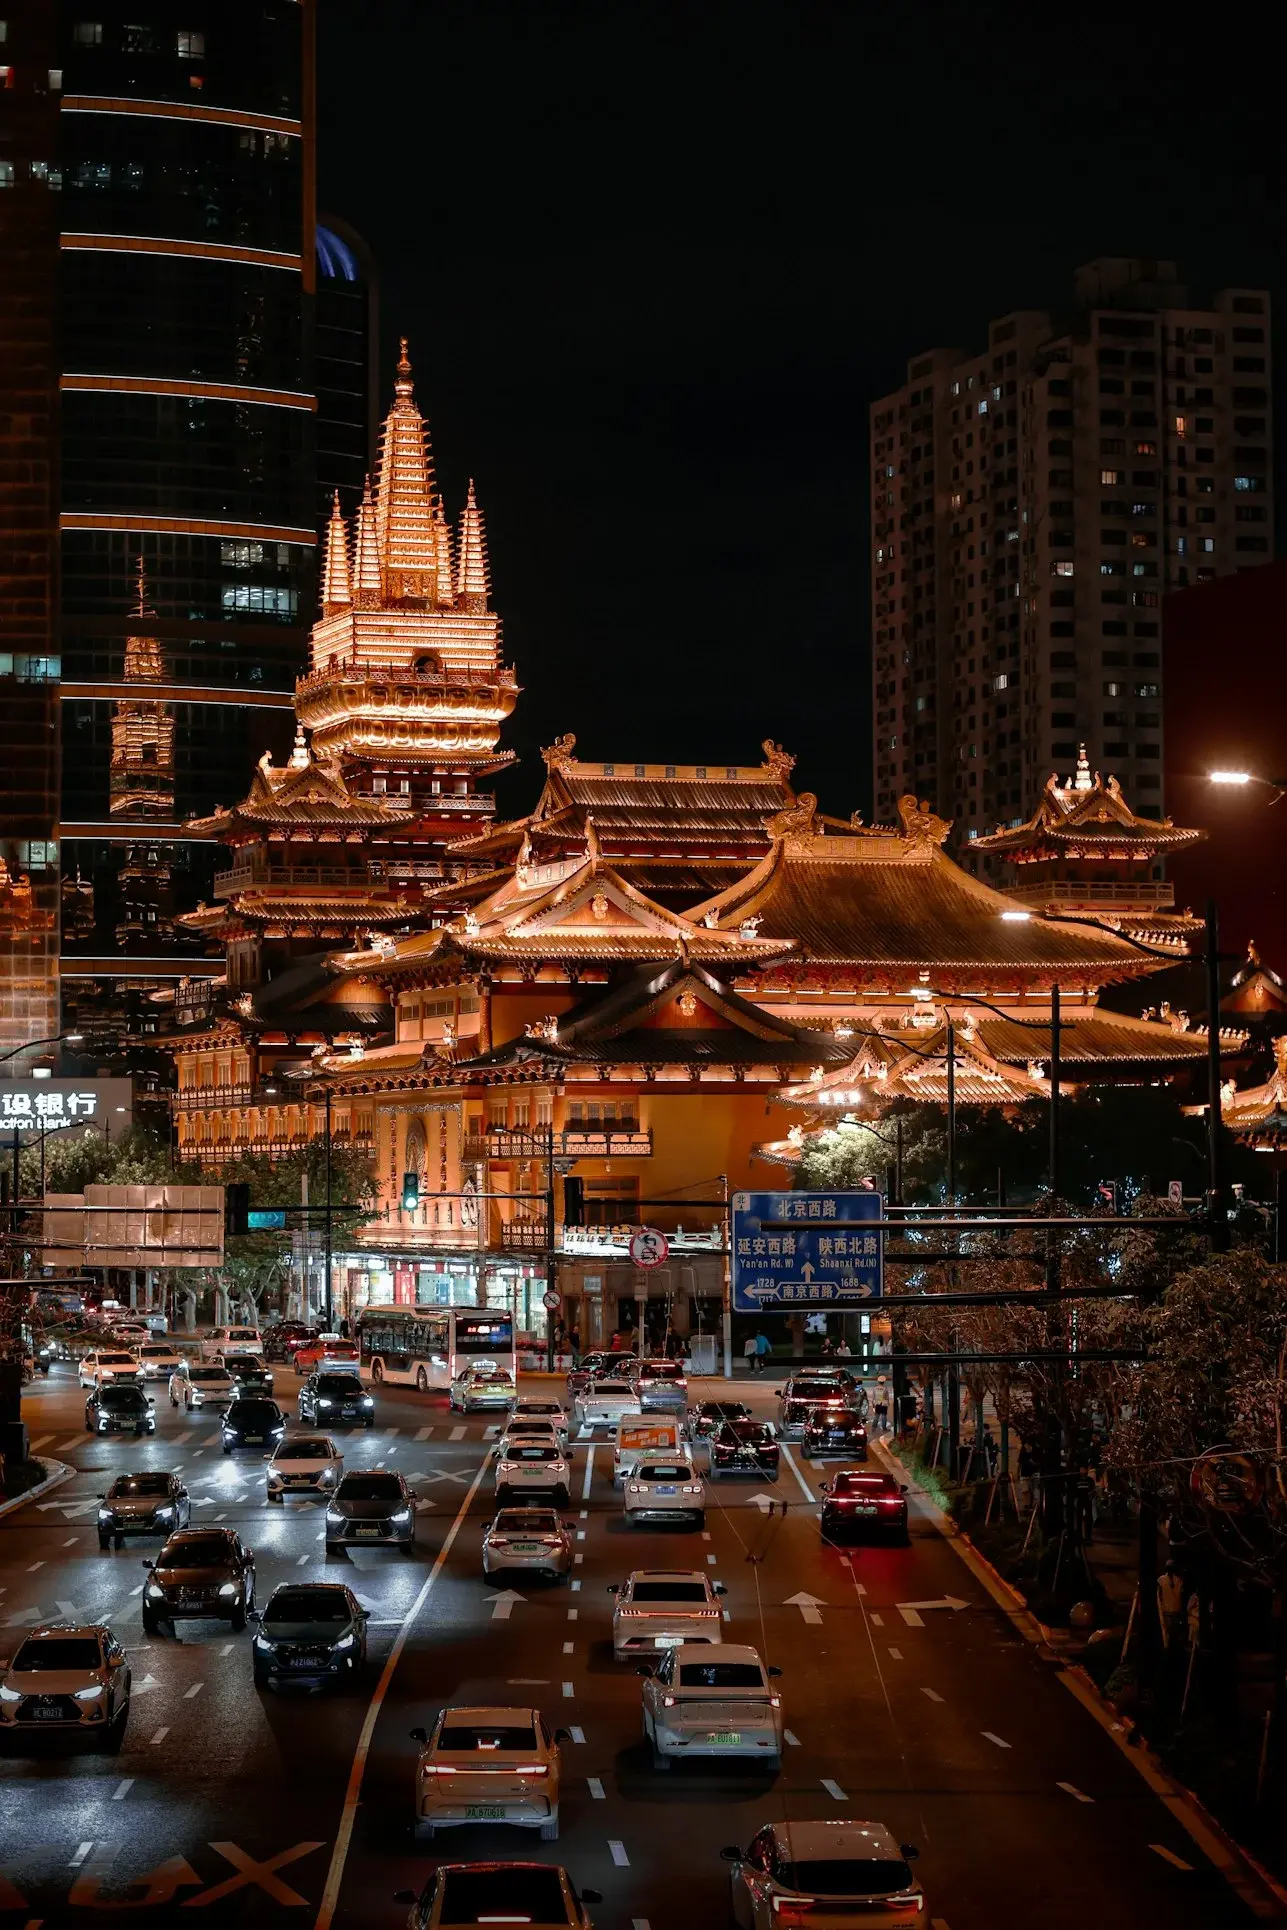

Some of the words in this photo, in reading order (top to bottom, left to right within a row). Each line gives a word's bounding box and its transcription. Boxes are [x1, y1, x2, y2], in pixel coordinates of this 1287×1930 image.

[2, 1093, 97, 1117] 设银行
[778, 1200, 836, 1217] 北京西路
[737, 1237, 796, 1255] 延安西路
[818, 1237, 878, 1255] 陕西北路
[740, 1259, 768, 1269] Yan'an
[820, 1258, 852, 1269] Shaanxi
[757, 1278, 775, 1288] 1728
[841, 1278, 859, 1287] 1688
[783, 1285, 833, 1299] 南京西路
